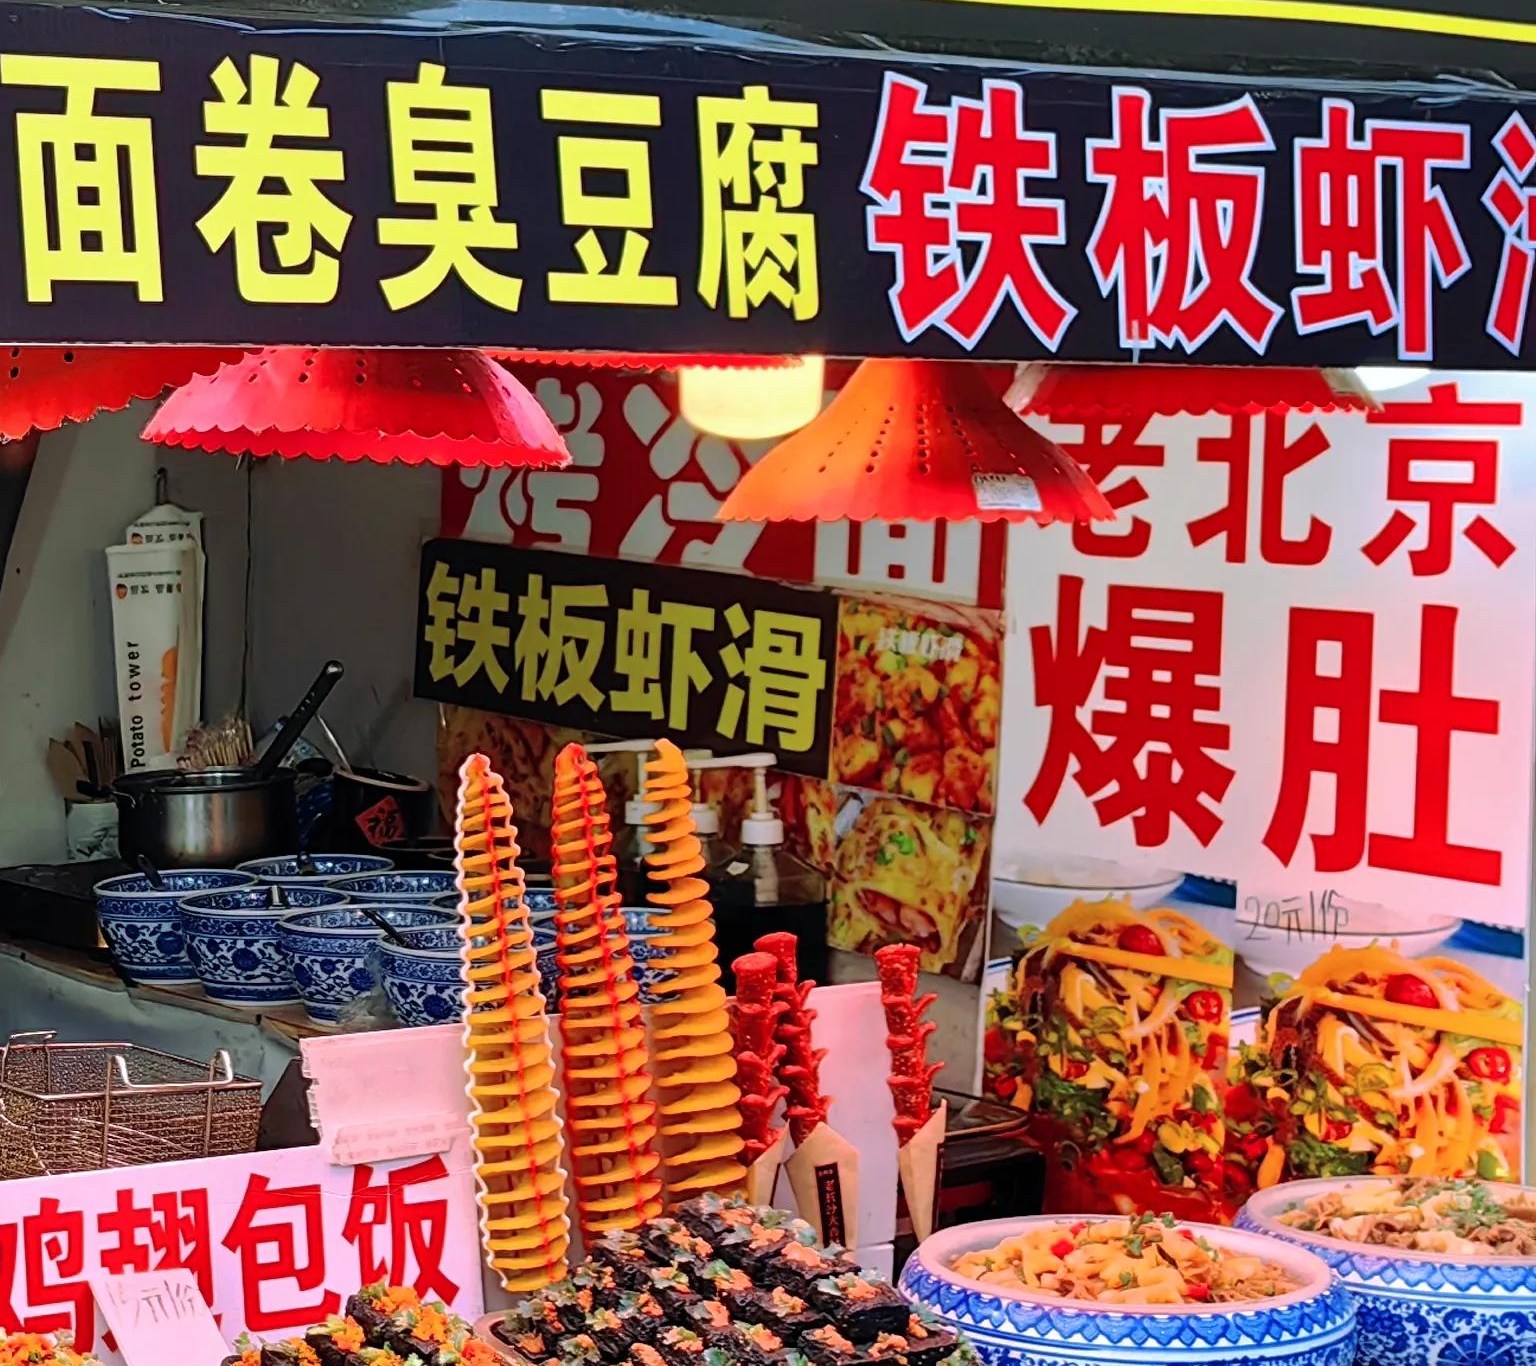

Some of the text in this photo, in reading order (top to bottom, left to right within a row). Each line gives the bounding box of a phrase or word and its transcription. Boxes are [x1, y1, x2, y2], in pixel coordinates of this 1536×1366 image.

[1035, 382, 1524, 577] 老北京
[126, 641, 147, 769] Potato tower
[423, 559, 827, 753] 铁板虾滑
[1022, 573, 1503, 887] 爆肚
